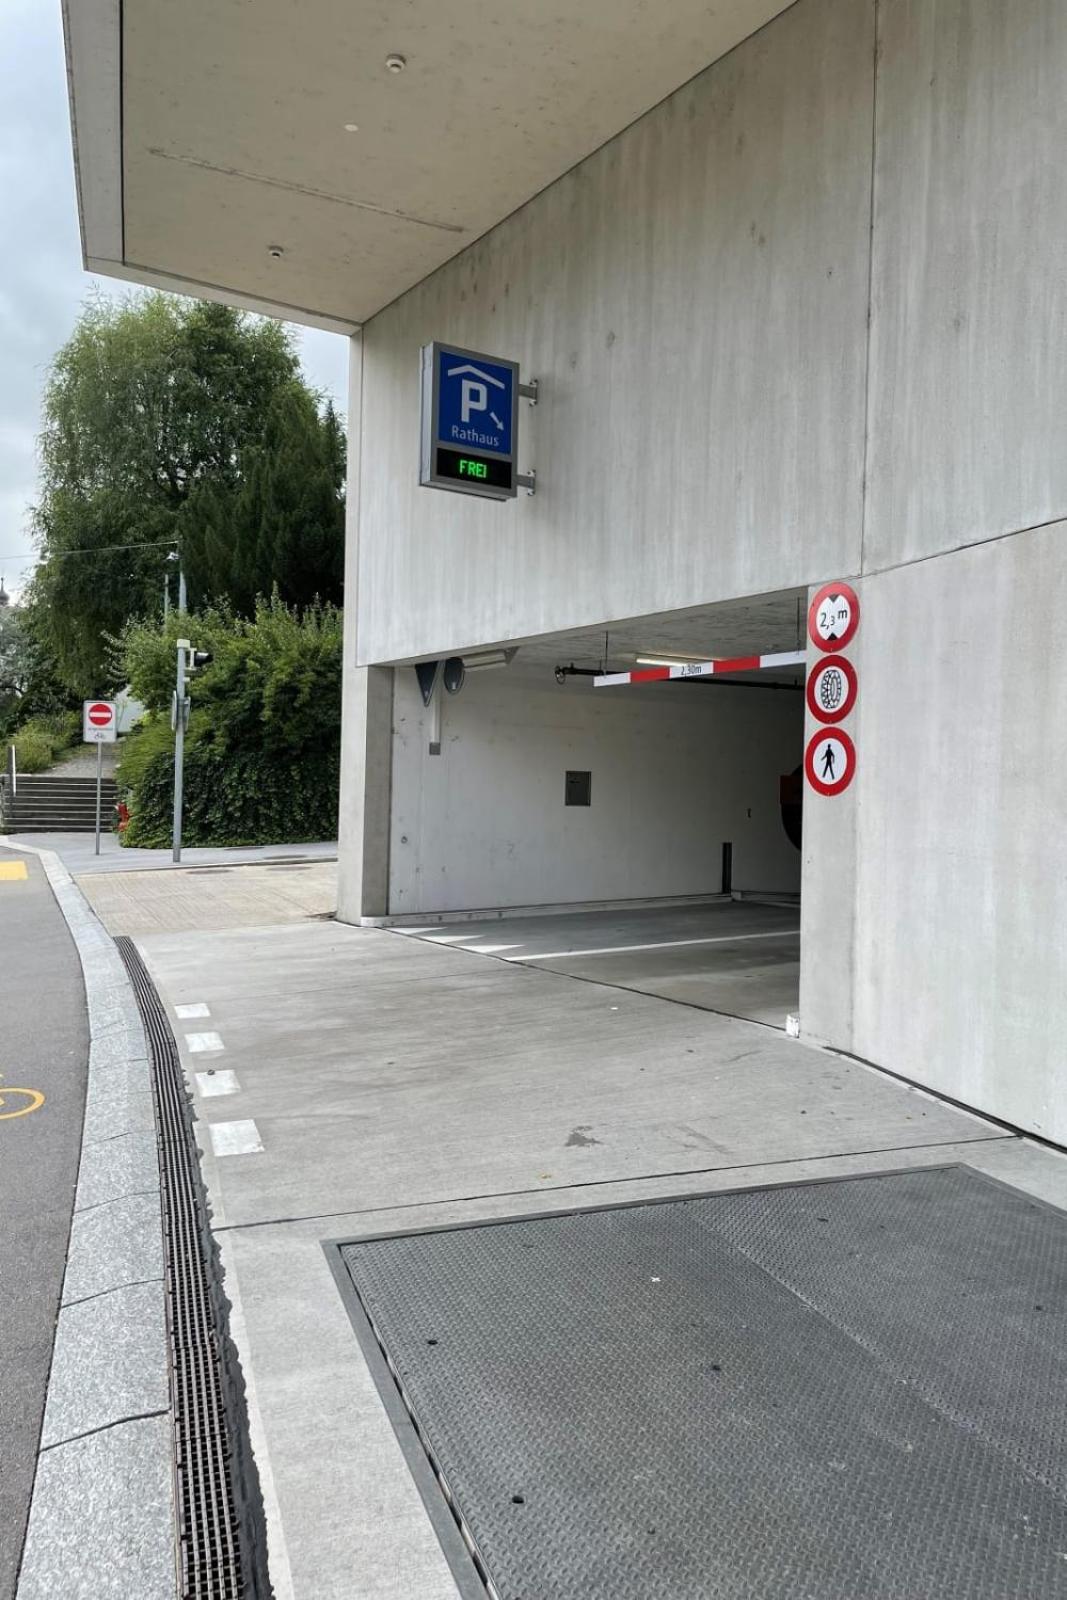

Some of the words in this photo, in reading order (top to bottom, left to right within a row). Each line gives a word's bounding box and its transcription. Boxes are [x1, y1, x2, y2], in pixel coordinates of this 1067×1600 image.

[461, 379, 488, 423] P
[452, 425, 500, 447] Rathaus
[459, 459, 488, 479] FREI
